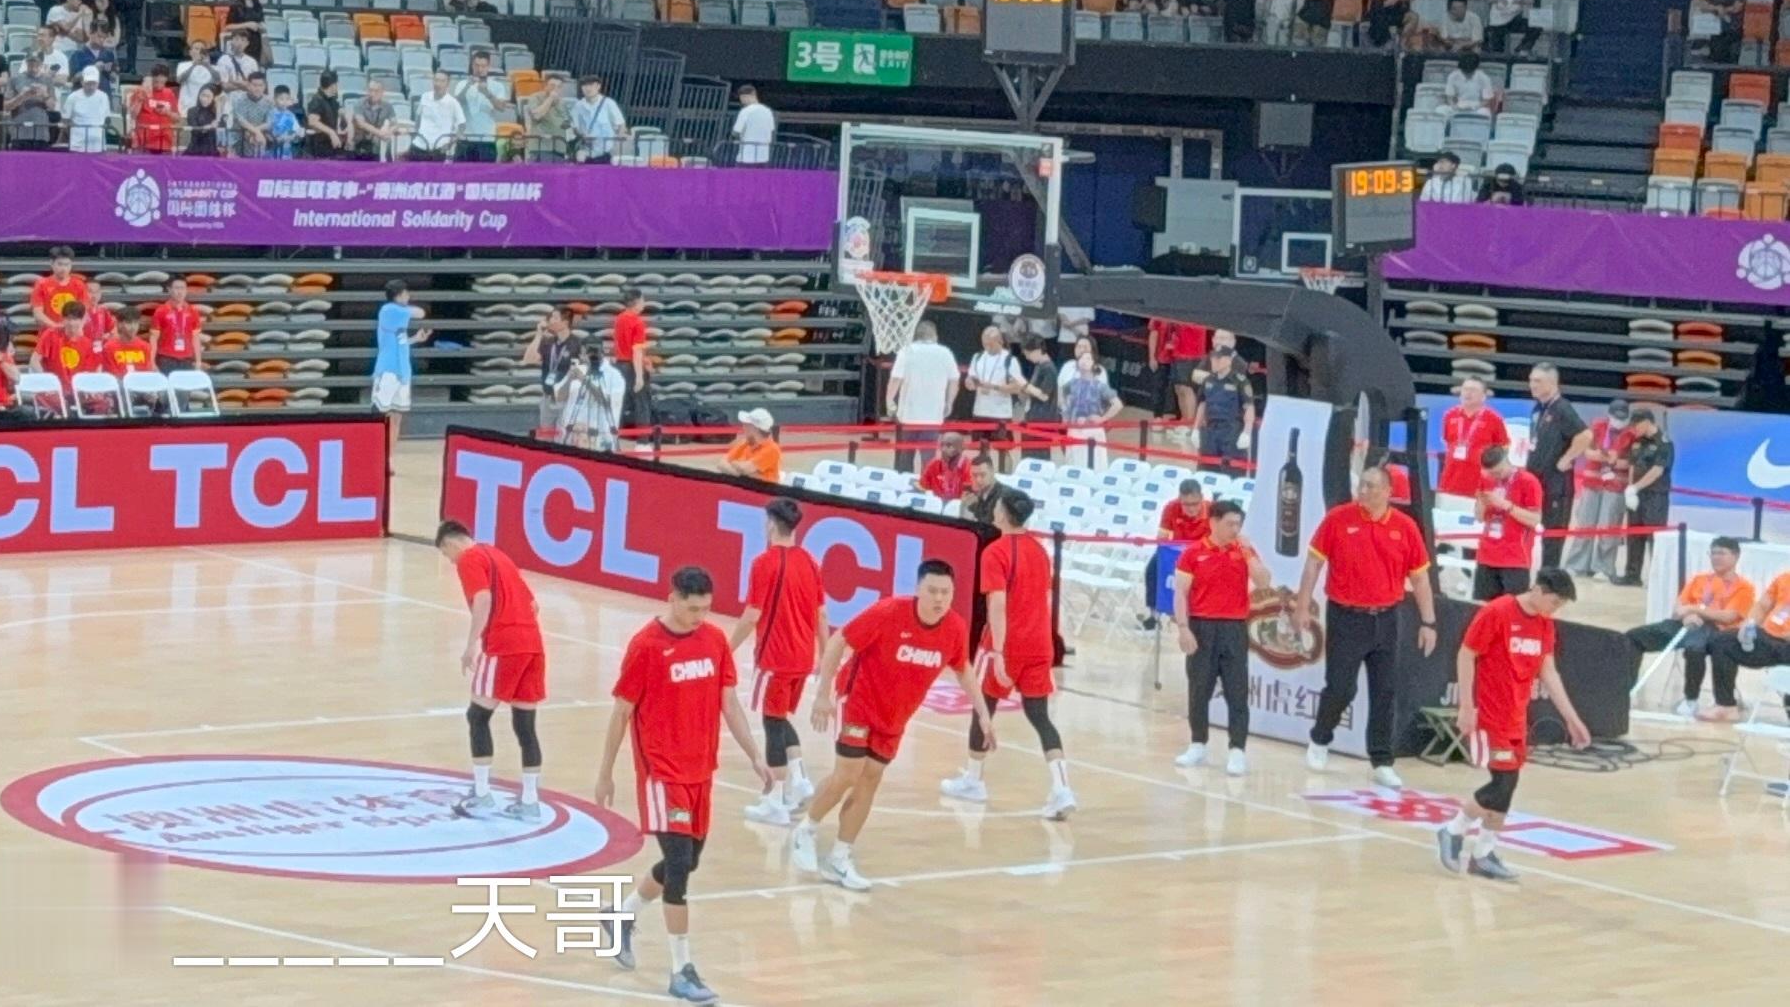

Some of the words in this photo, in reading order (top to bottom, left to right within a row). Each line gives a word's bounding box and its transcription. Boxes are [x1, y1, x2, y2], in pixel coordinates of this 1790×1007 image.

[795, 41, 843, 72] 3号
[1350, 168, 1414, 197] 19:09.3
[293, 209, 396, 228] International
[402, 209, 475, 232] Solidarity
[479, 210, 508, 232] Cup
[150, 436, 377, 528] TCL
[455, 450, 660, 583] TCL
[669, 657, 716, 684] CHINA
[896, 644, 942, 670] CHINA
